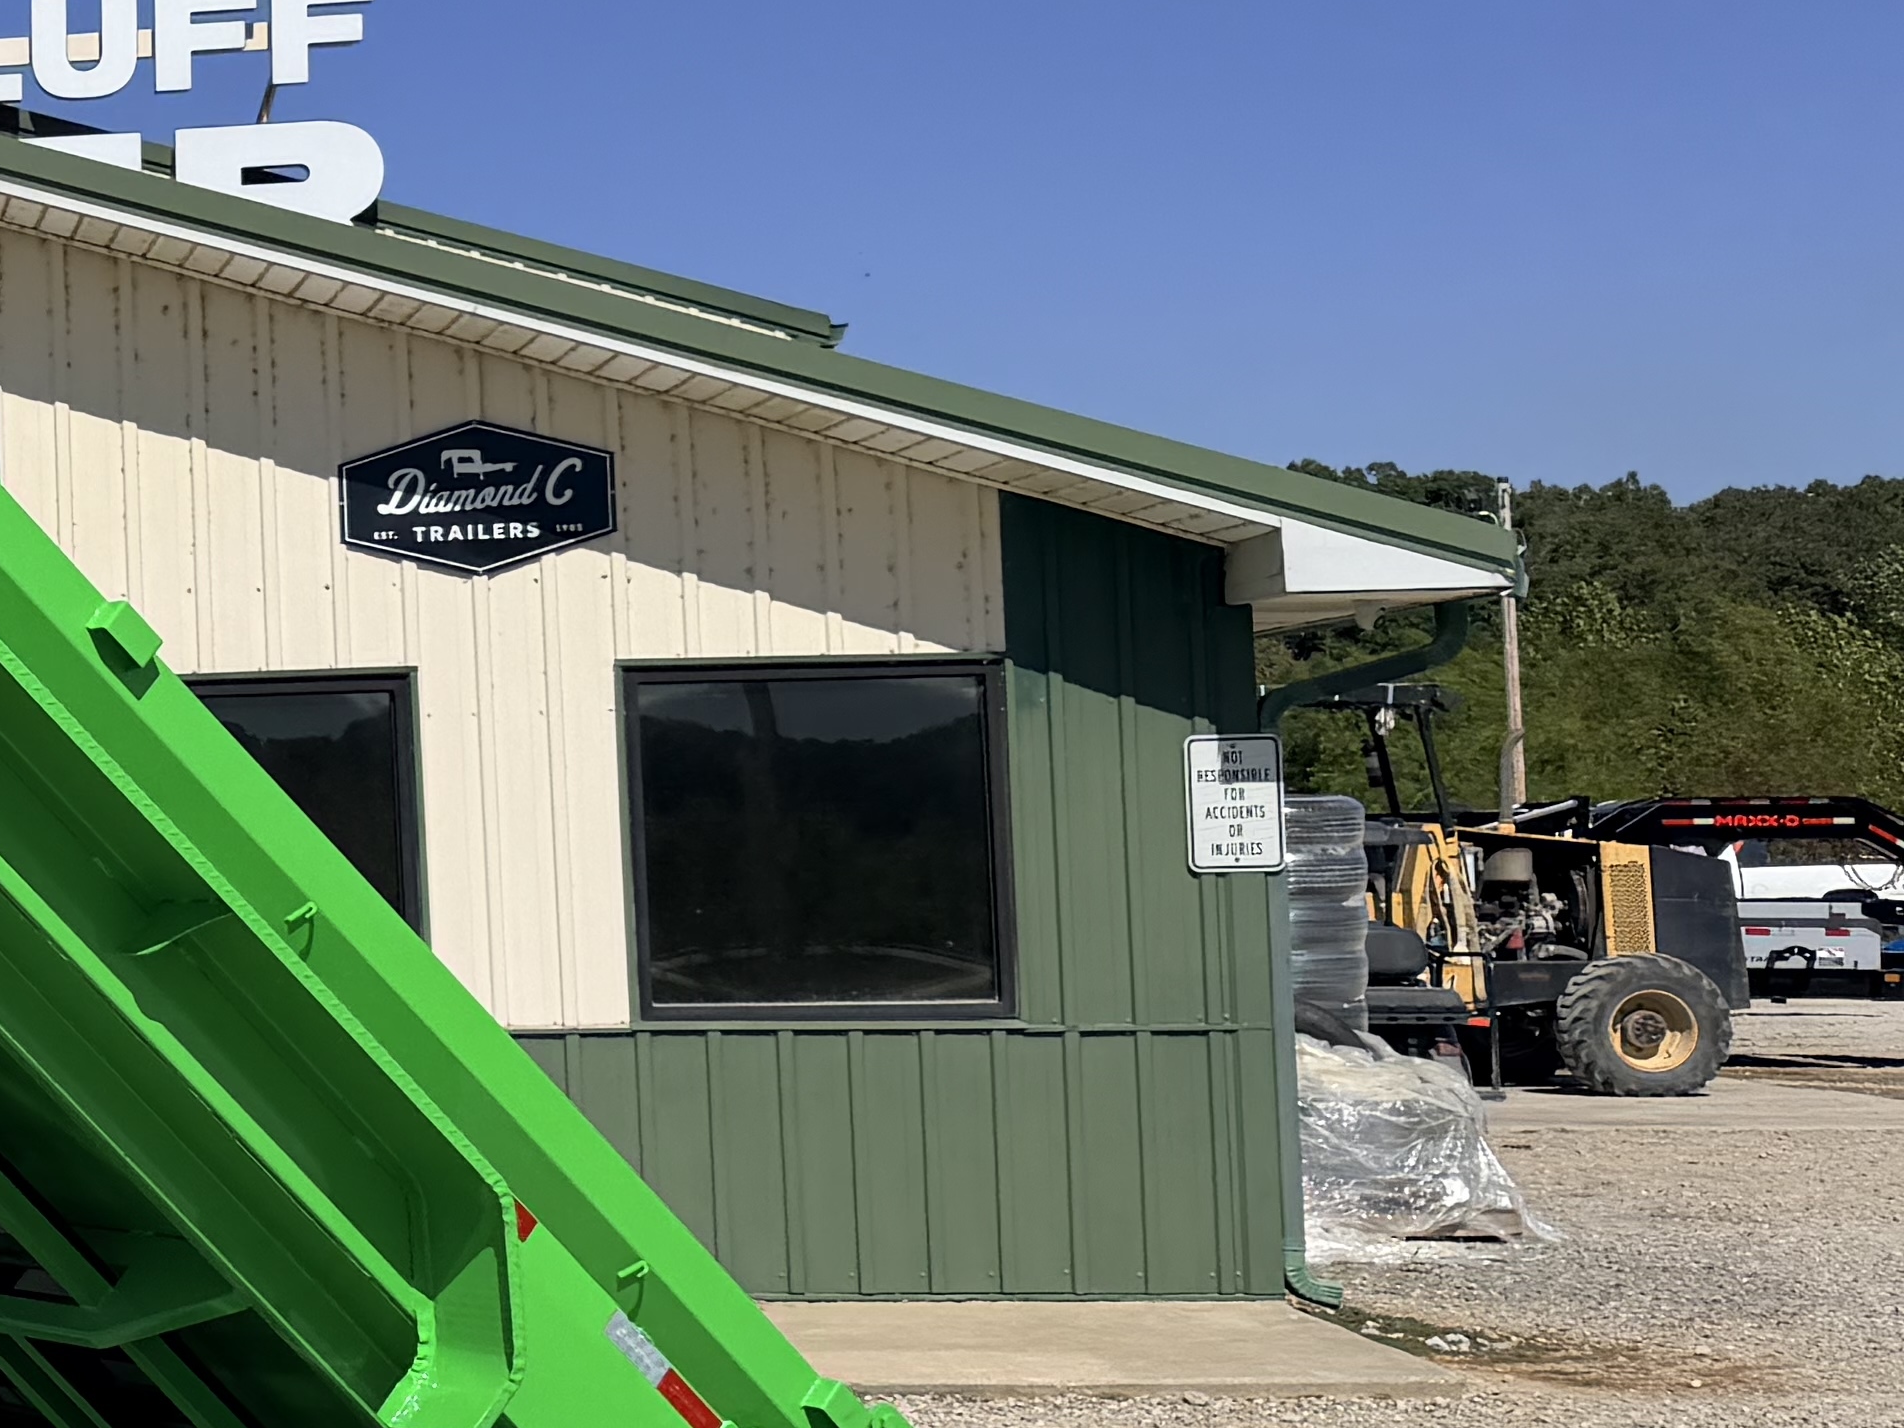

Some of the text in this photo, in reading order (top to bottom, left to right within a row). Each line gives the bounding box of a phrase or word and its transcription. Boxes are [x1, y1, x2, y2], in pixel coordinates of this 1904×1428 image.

[376, 456, 583, 516] Diamond C
[411, 521, 541, 543] TRAILERS
[1221, 750, 1243, 765] NOT
[1196, 767, 1272, 783] RESPONSIBLE
[1223, 787, 1246, 801] FOR
[1204, 804, 1266, 820] ACCIDENTS
[1228, 824, 1243, 837] OR
[1211, 842, 1264, 856] INJURIES
